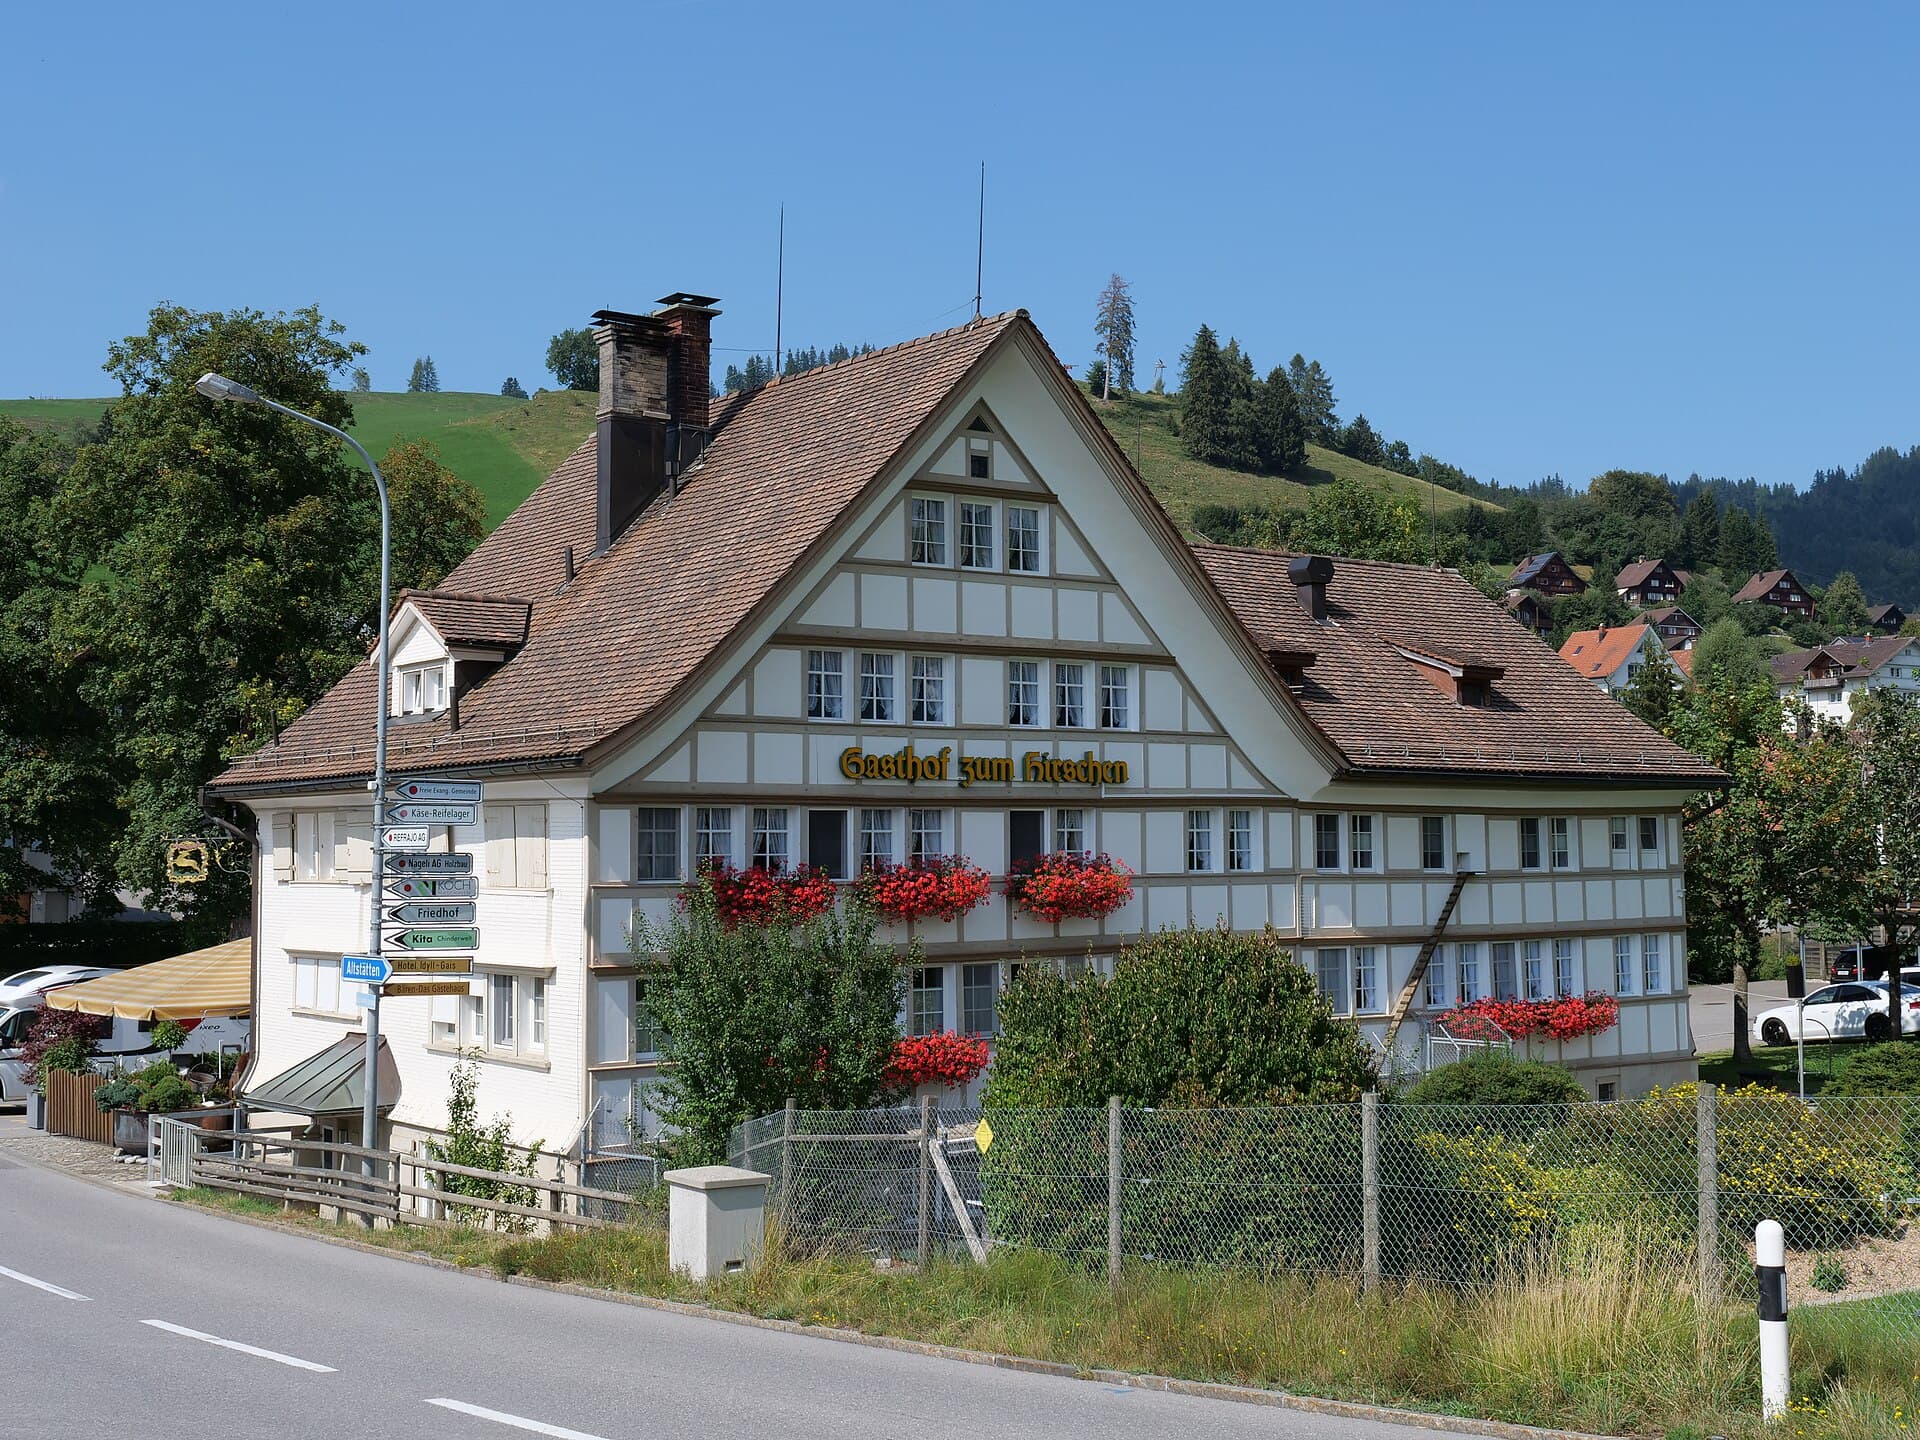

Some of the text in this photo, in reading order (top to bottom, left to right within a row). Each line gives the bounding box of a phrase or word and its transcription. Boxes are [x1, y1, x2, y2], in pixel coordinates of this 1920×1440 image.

[840, 746, 1129, 788] Gasthof zum Hirschen
[411, 809, 470, 819] Käse-Reifelager
[418, 833, 426, 841] AG
[431, 859, 442, 868] AG
[444, 860, 468, 868] Holzbau
[438, 880, 471, 890] KOCH
[417, 907, 459, 918] Friedhof
[412, 934, 433, 943] Kita
[346, 960, 380, 977] Altstätten
[397, 960, 417, 970] Hotel
